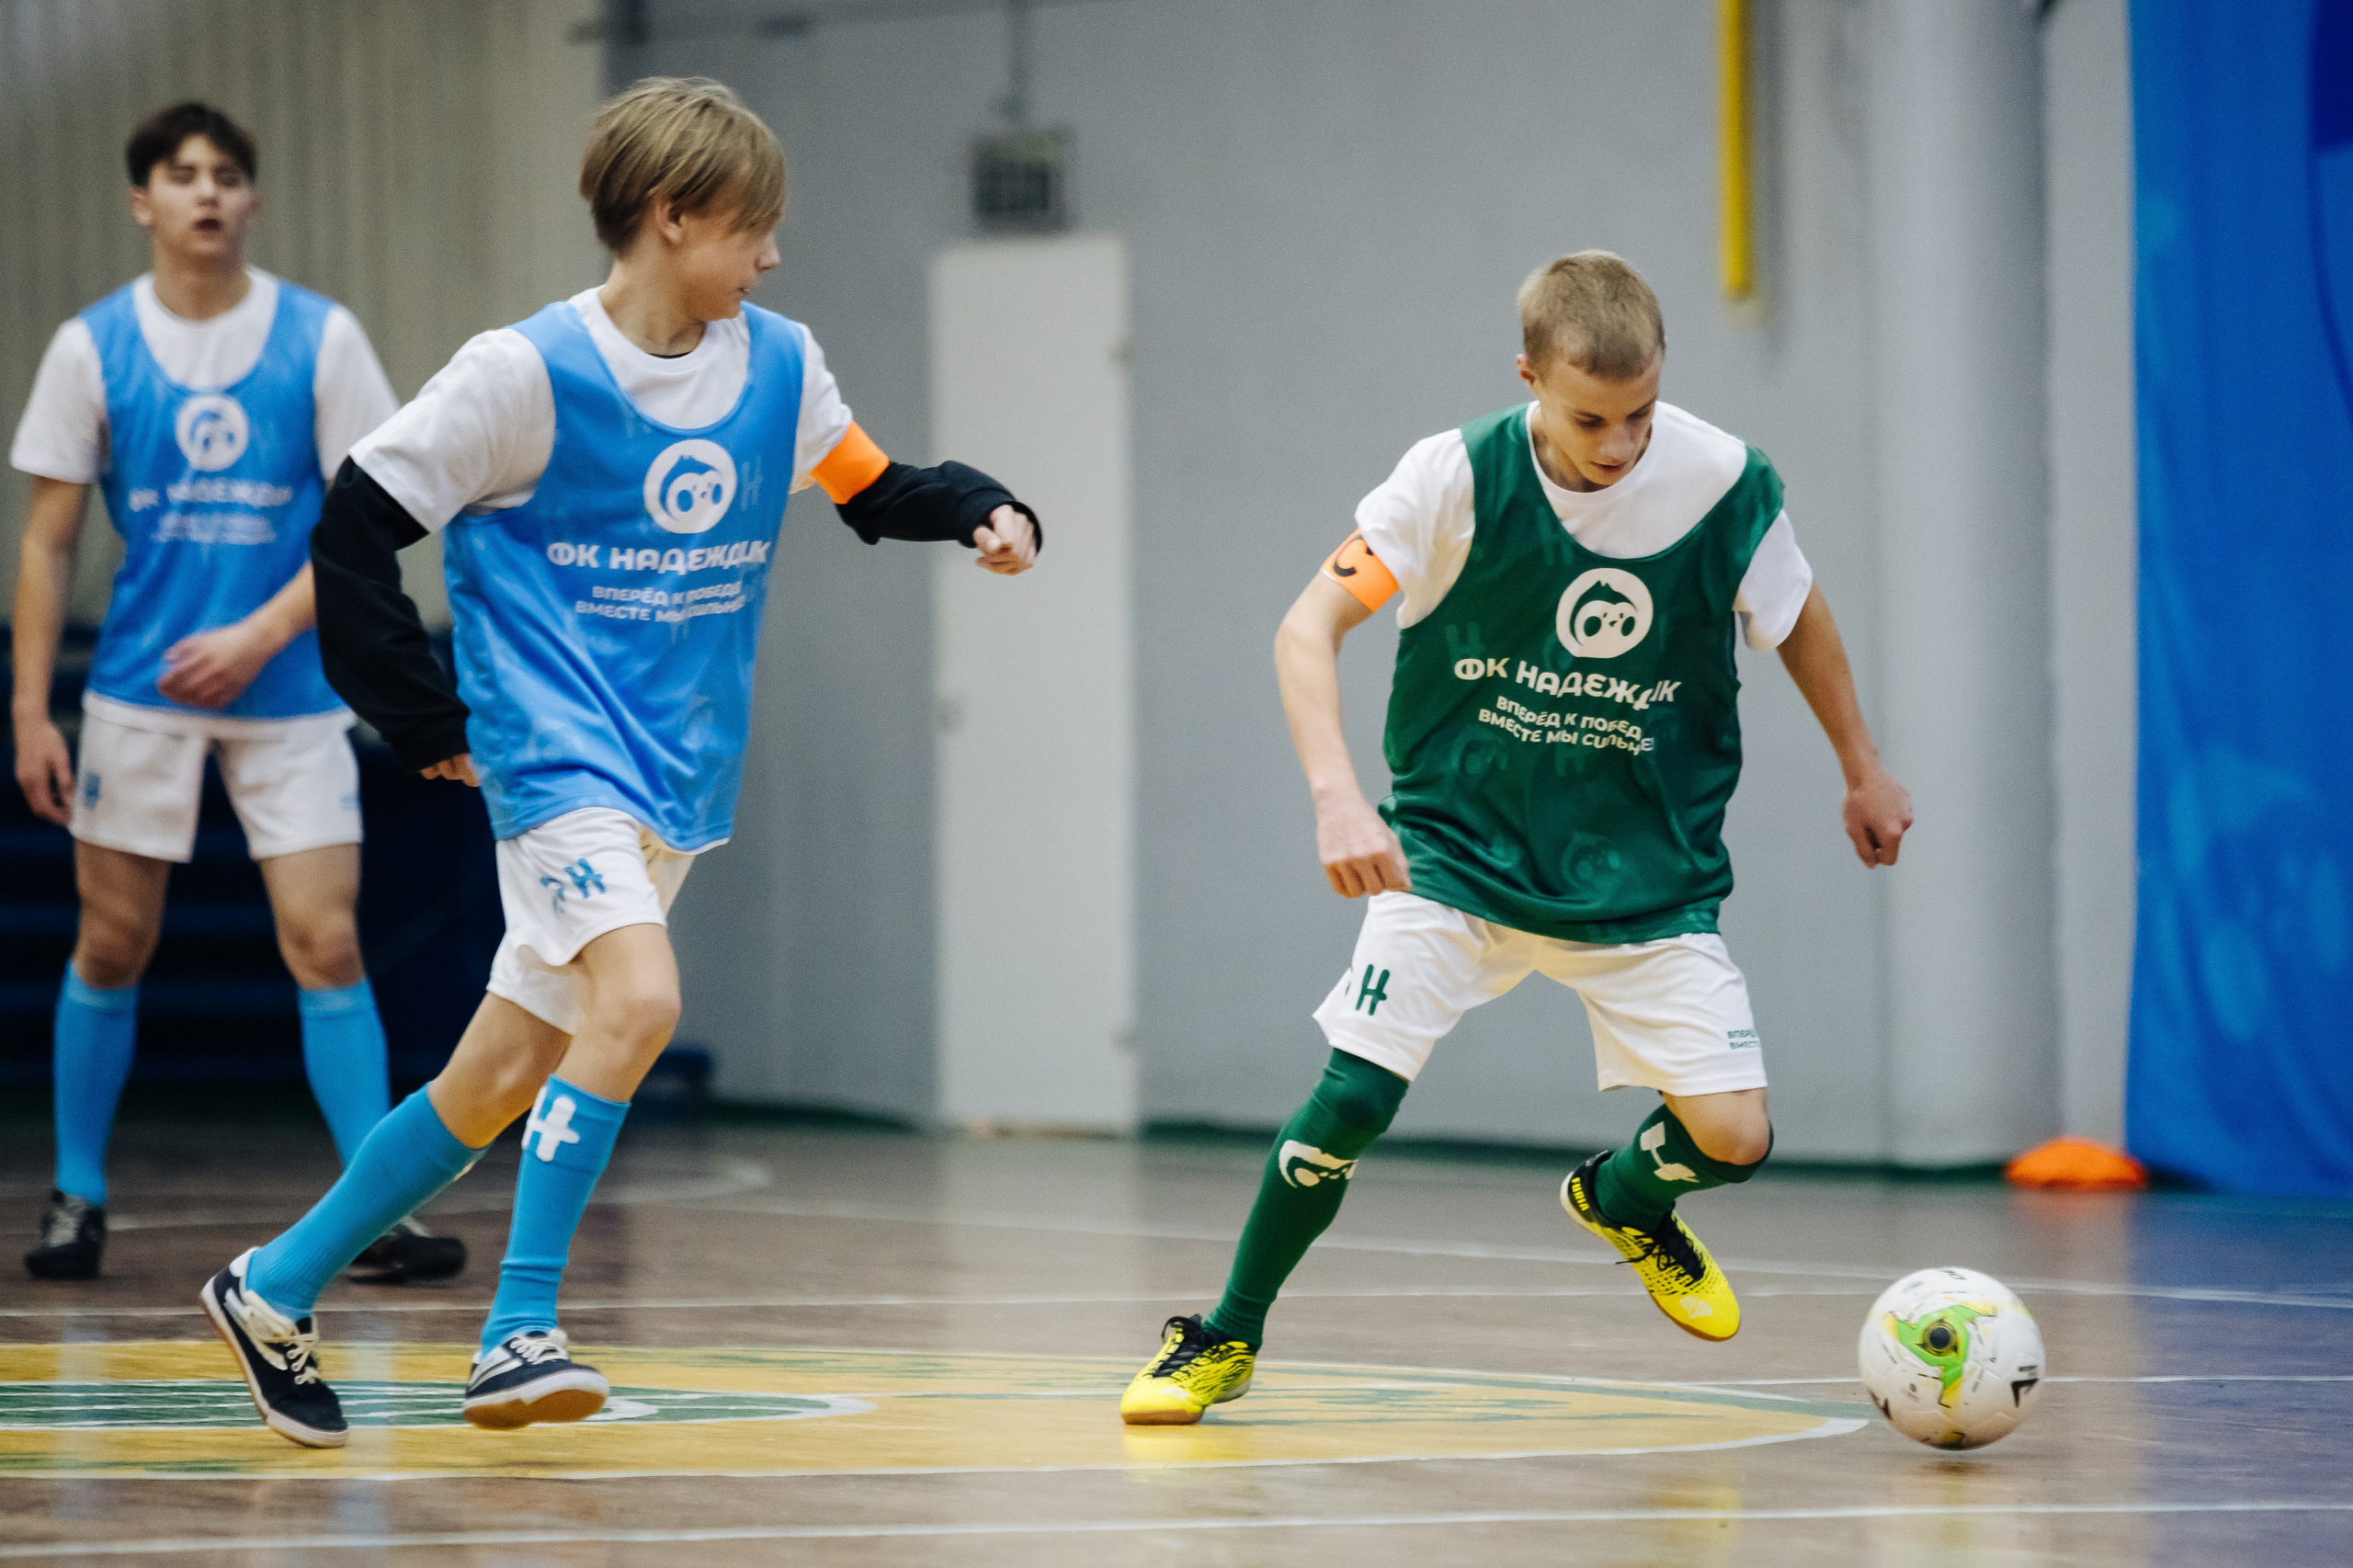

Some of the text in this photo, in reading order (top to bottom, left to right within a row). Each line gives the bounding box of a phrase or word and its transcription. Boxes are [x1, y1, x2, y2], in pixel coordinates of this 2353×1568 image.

[546, 541, 600, 568] ФК
[574, 600, 651, 620] ВМЕСТЕ
[1454, 657, 1510, 681] ФК
[1496, 696, 1561, 728] ВПЕРЁД
[1563, 713, 1578, 725] К
[1478, 708, 1543, 743] ВМЕСТЕ
[1546, 730, 1579, 744] МЫ
